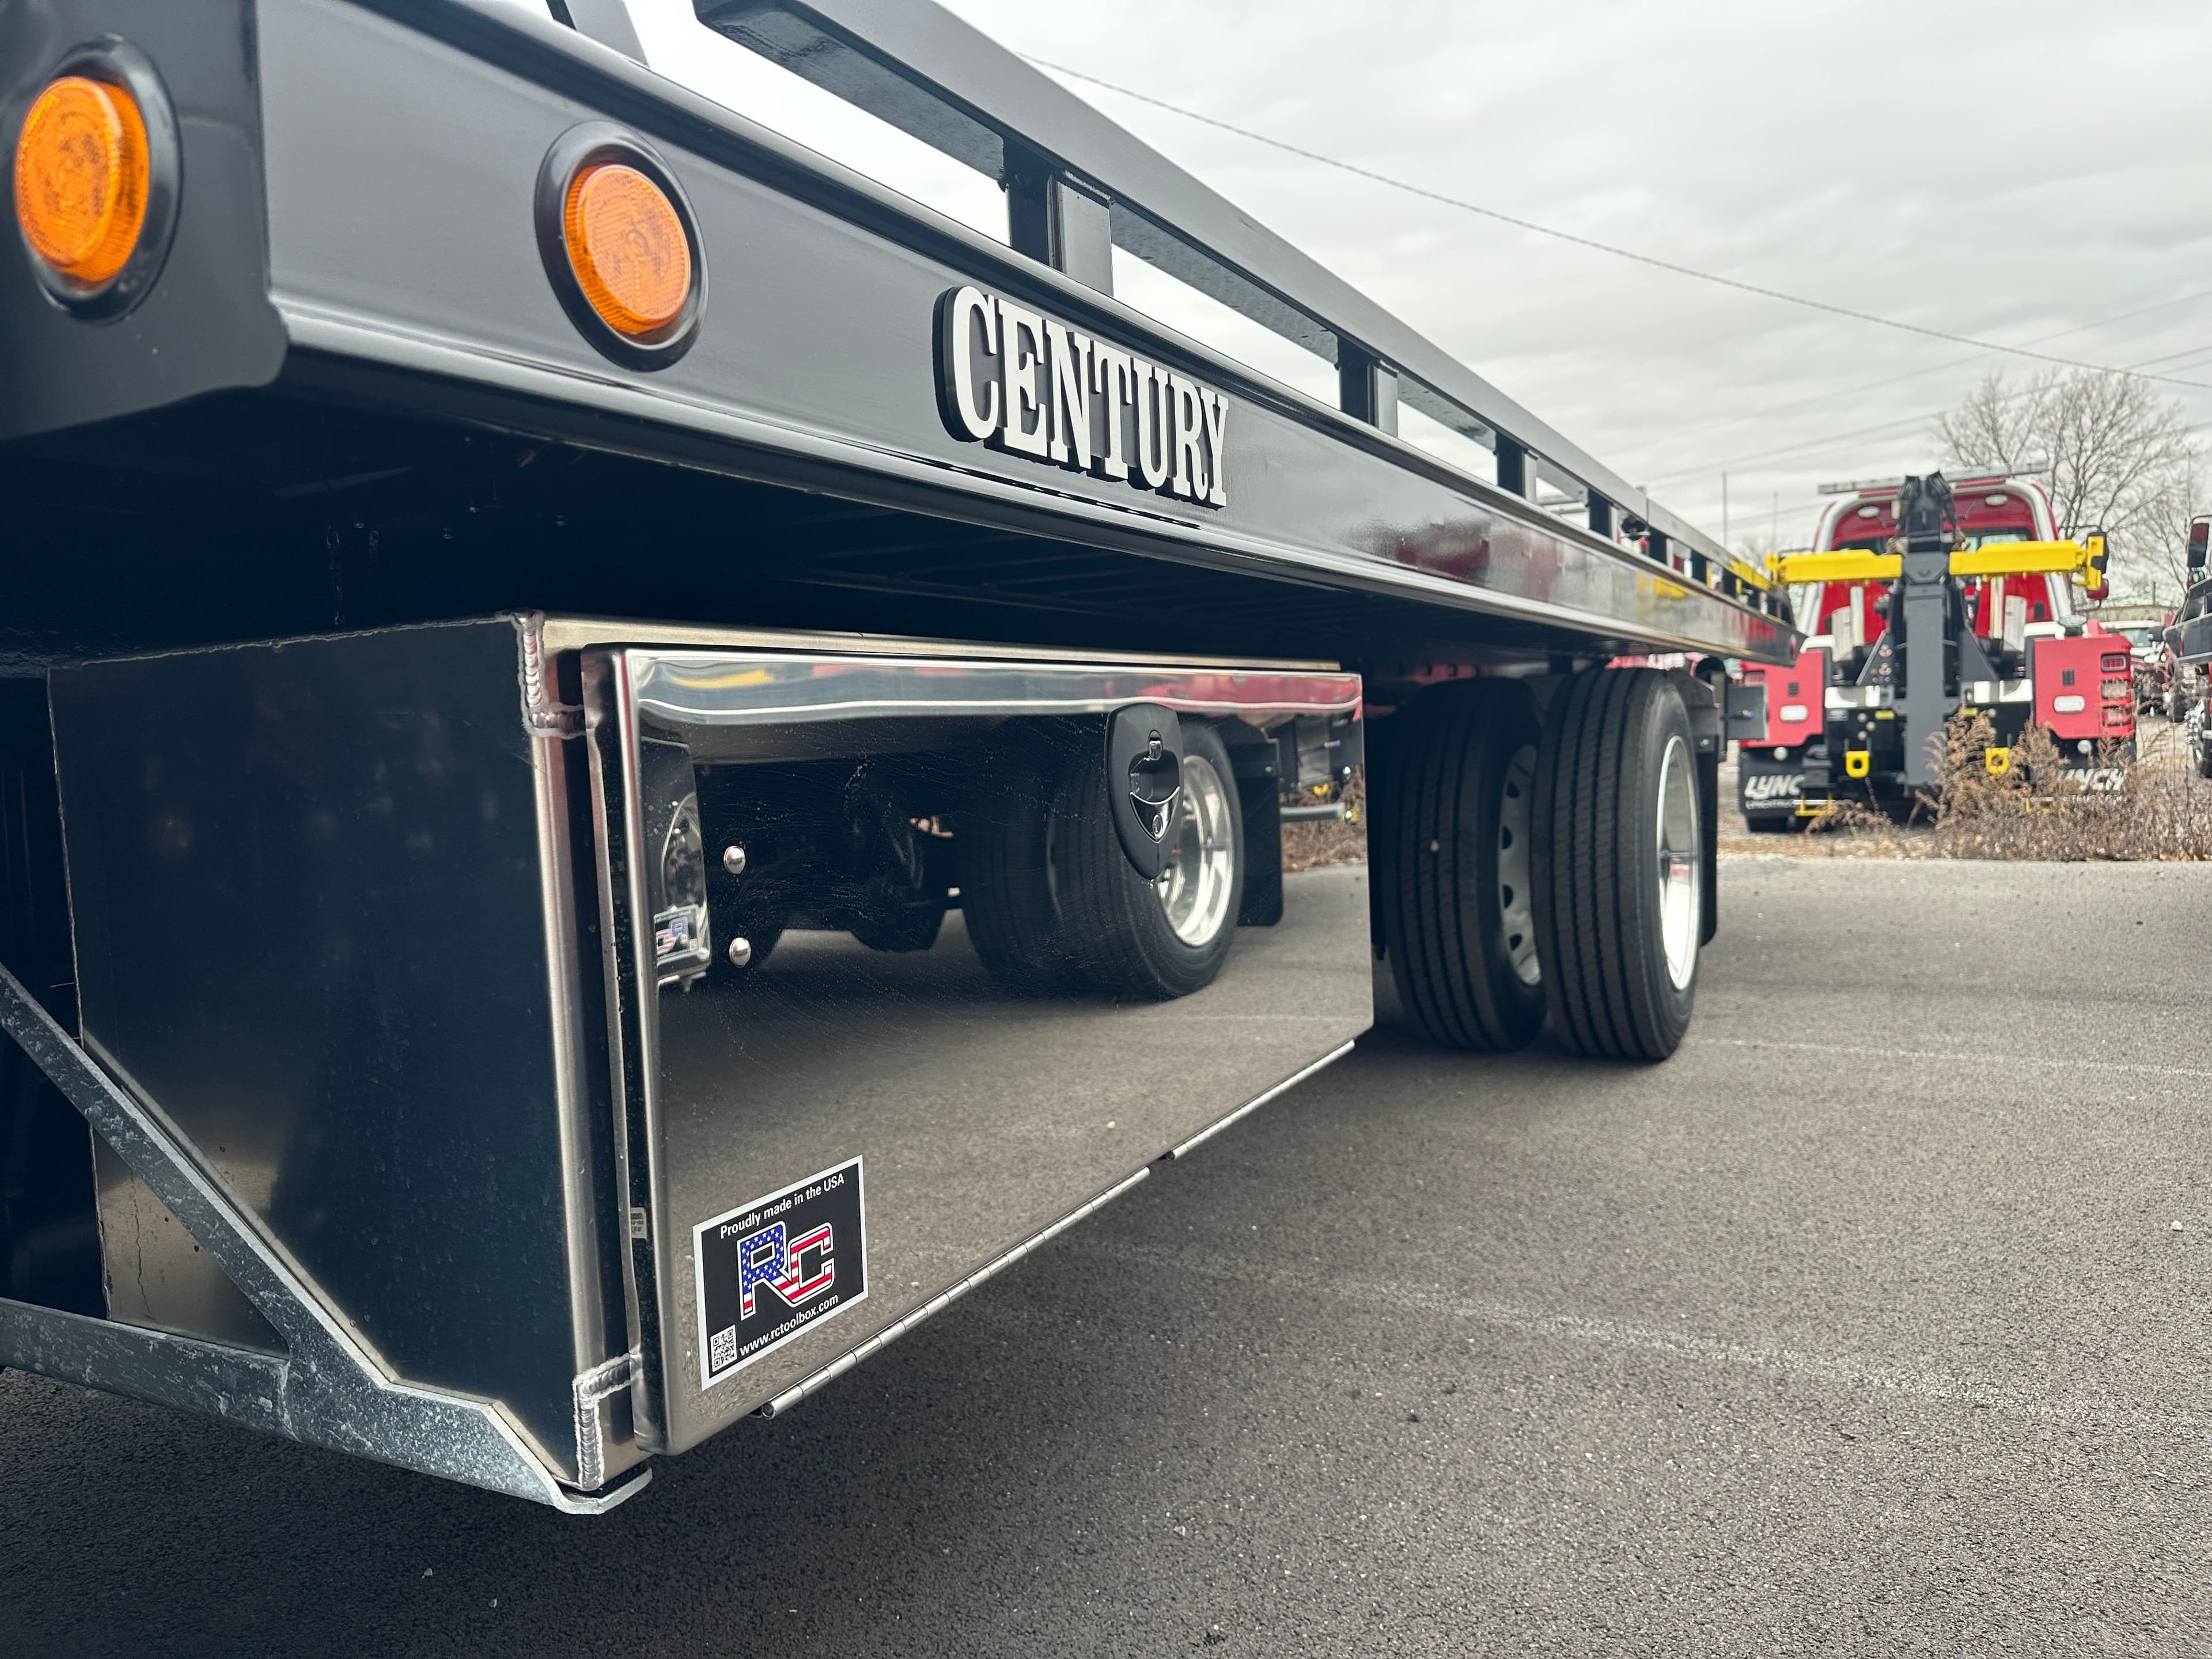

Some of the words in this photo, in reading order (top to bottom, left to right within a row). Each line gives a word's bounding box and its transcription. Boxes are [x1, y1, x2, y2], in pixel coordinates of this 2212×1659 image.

[953, 286, 1229, 507] CENTURY
[1744, 774, 1806, 800] LYNC
[2056, 768, 2125, 791] NCH
[720, 1213, 761, 1239] Proudly
[764, 1198, 792, 1219] made
[794, 1194, 804, 1206] in
[805, 1184, 821, 1200] the
[824, 1173, 844, 1192] USA
[737, 1221, 835, 1321] RC
[740, 1294, 839, 1356] www.rctoolbox.com
